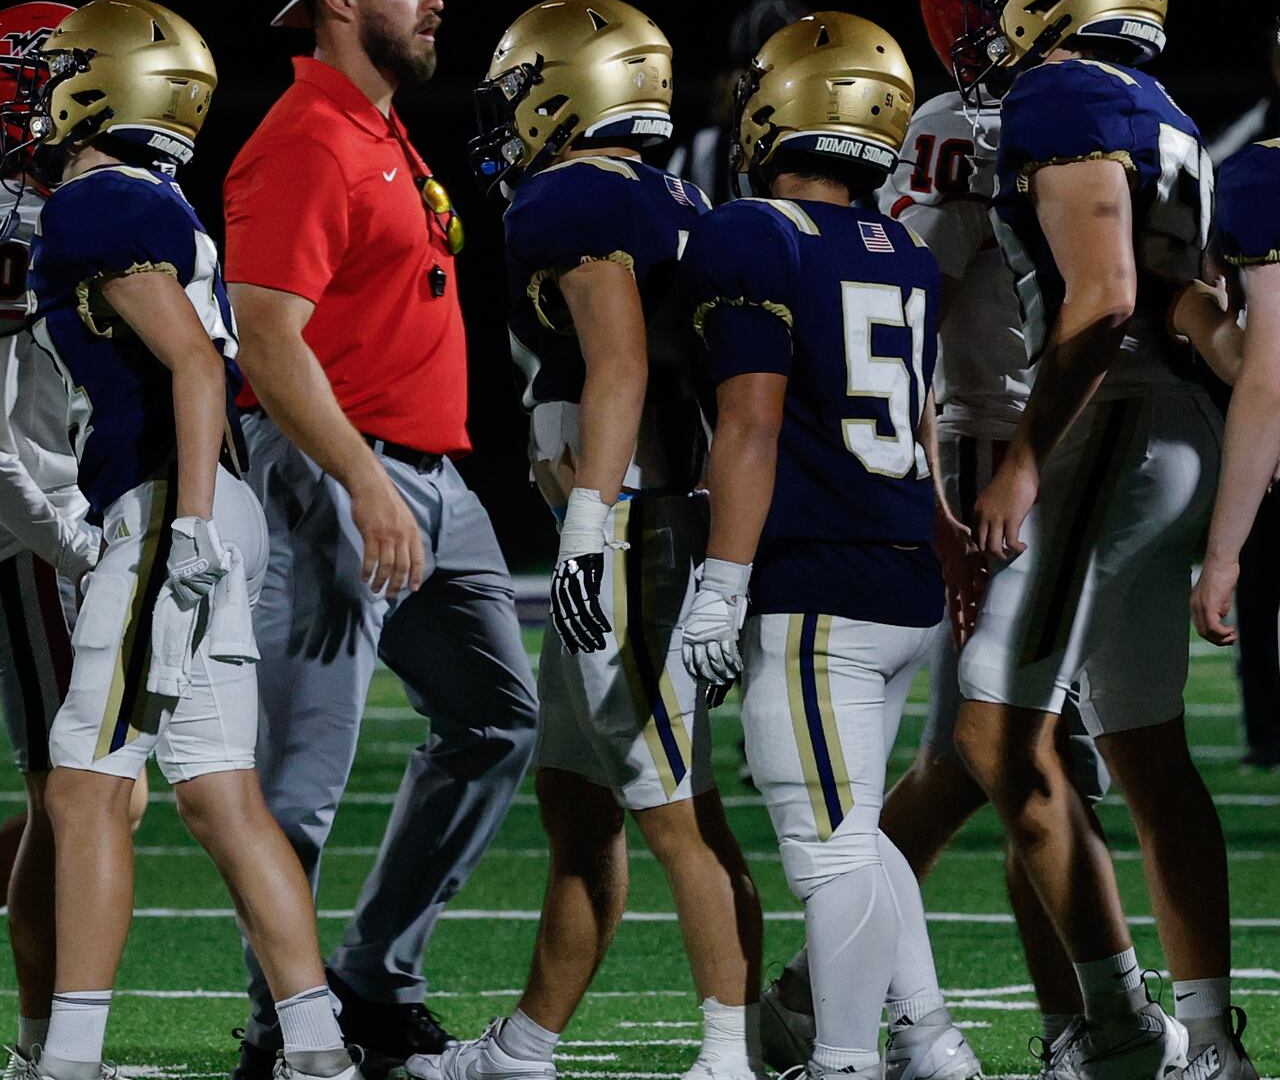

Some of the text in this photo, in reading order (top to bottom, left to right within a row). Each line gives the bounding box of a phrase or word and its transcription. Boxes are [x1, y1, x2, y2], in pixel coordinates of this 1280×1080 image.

[885, 93, 894, 108] 51
[815, 136, 863, 157] DOMINI
[910, 134, 974, 194] 10
[840, 280, 931, 480] 51
